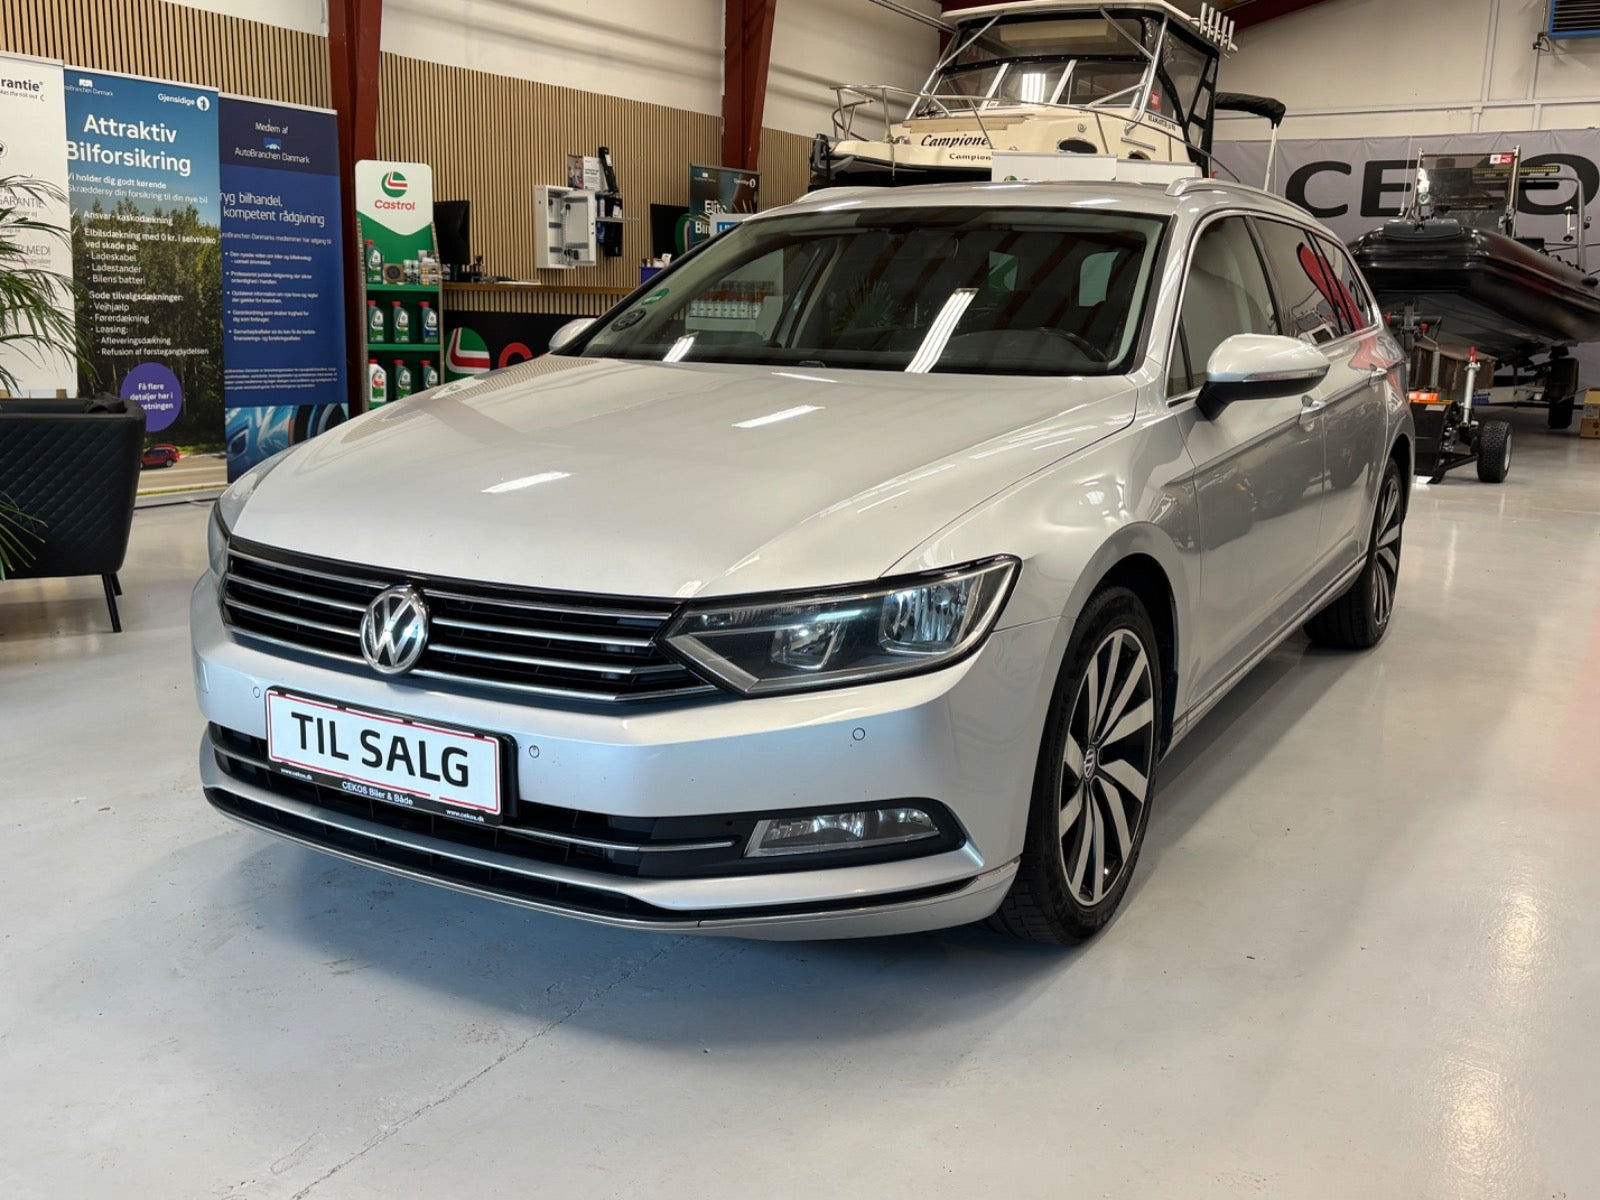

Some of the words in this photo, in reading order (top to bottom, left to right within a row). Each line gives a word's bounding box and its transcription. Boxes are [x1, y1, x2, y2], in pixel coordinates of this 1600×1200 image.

[157, 93, 196, 106] Gjensidige
[83, 114, 177, 143] Attraktiv
[255, 121, 281, 134] Medlem
[66, 140, 191, 177] Bilforsikring
[234, 147, 281, 161] AutoBranchen
[282, 153, 311, 164] Danmark
[76, 173, 102, 183] holder
[103, 176, 116, 186] dig
[117, 177, 135, 187] godt
[136, 179, 167, 190] kørende
[114, 188, 127, 197] din
[128, 189, 163, 202] forsikring
[220, 191, 236, 207] ryg
[239, 192, 283, 208] bilhandel,
[374, 199, 416, 211] Castrol
[223, 206, 277, 222] kompetent
[279, 210, 325, 228] rådgivning
[142, 233, 160, 242] med
[85, 241, 101, 249] ved
[102, 241, 126, 250] skade
[91, 252, 137, 263] Ladeskabel
[92, 264, 142, 275] Ladestander
[92, 274, 118, 285] Bilens
[138, 382, 147, 391] Få
[147, 382, 165, 391] flere
[129, 393, 157, 402] detaljer
[157, 392, 170, 400] her
[291, 711, 350, 761] TIL
[360, 728, 470, 788] SALG
[280, 767, 314, 781] www.cekos.dk
[341, 781, 368, 795] CEKOS
[368, 787, 387, 799] Biler
[394, 792, 414, 806] Både
[445, 807, 486, 823] www.cekos.dk
